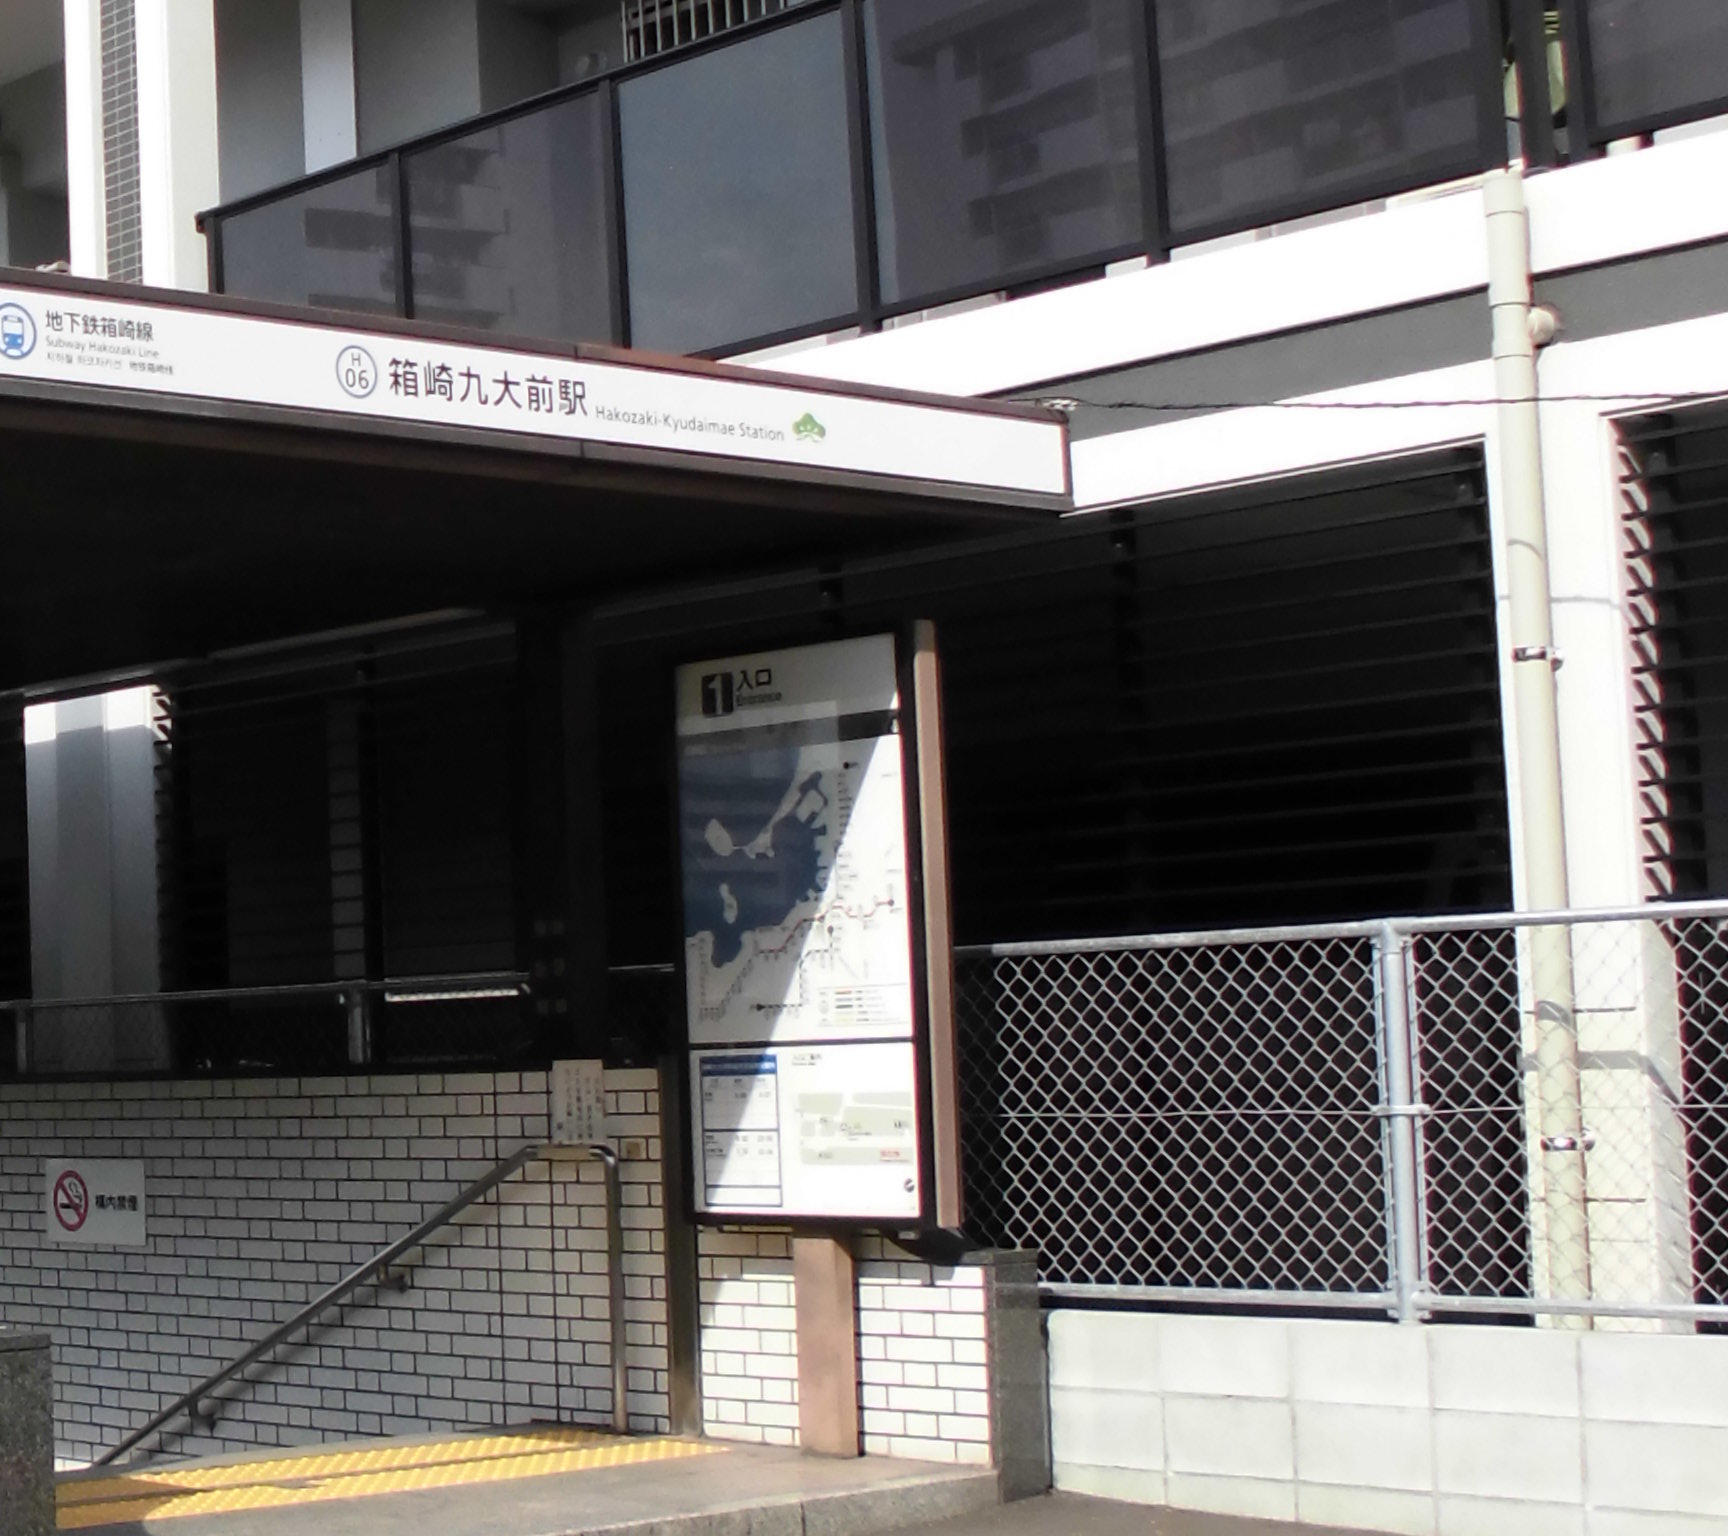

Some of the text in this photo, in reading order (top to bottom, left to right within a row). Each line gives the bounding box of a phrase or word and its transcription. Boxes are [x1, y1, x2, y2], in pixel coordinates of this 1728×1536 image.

[45, 309, 154, 342] 地下鉄箱崎線
[45, 335, 160, 359] Subway Hakozaki Line
[351, 353, 362, 367] H
[345, 368, 370, 390] 06
[388, 357, 589, 417] 箱崎九大前駅
[595, 405, 785, 442] Hakozaki-Kyudaimae Station
[708, 673, 723, 715] 1
[736, 668, 772, 692] 入口
